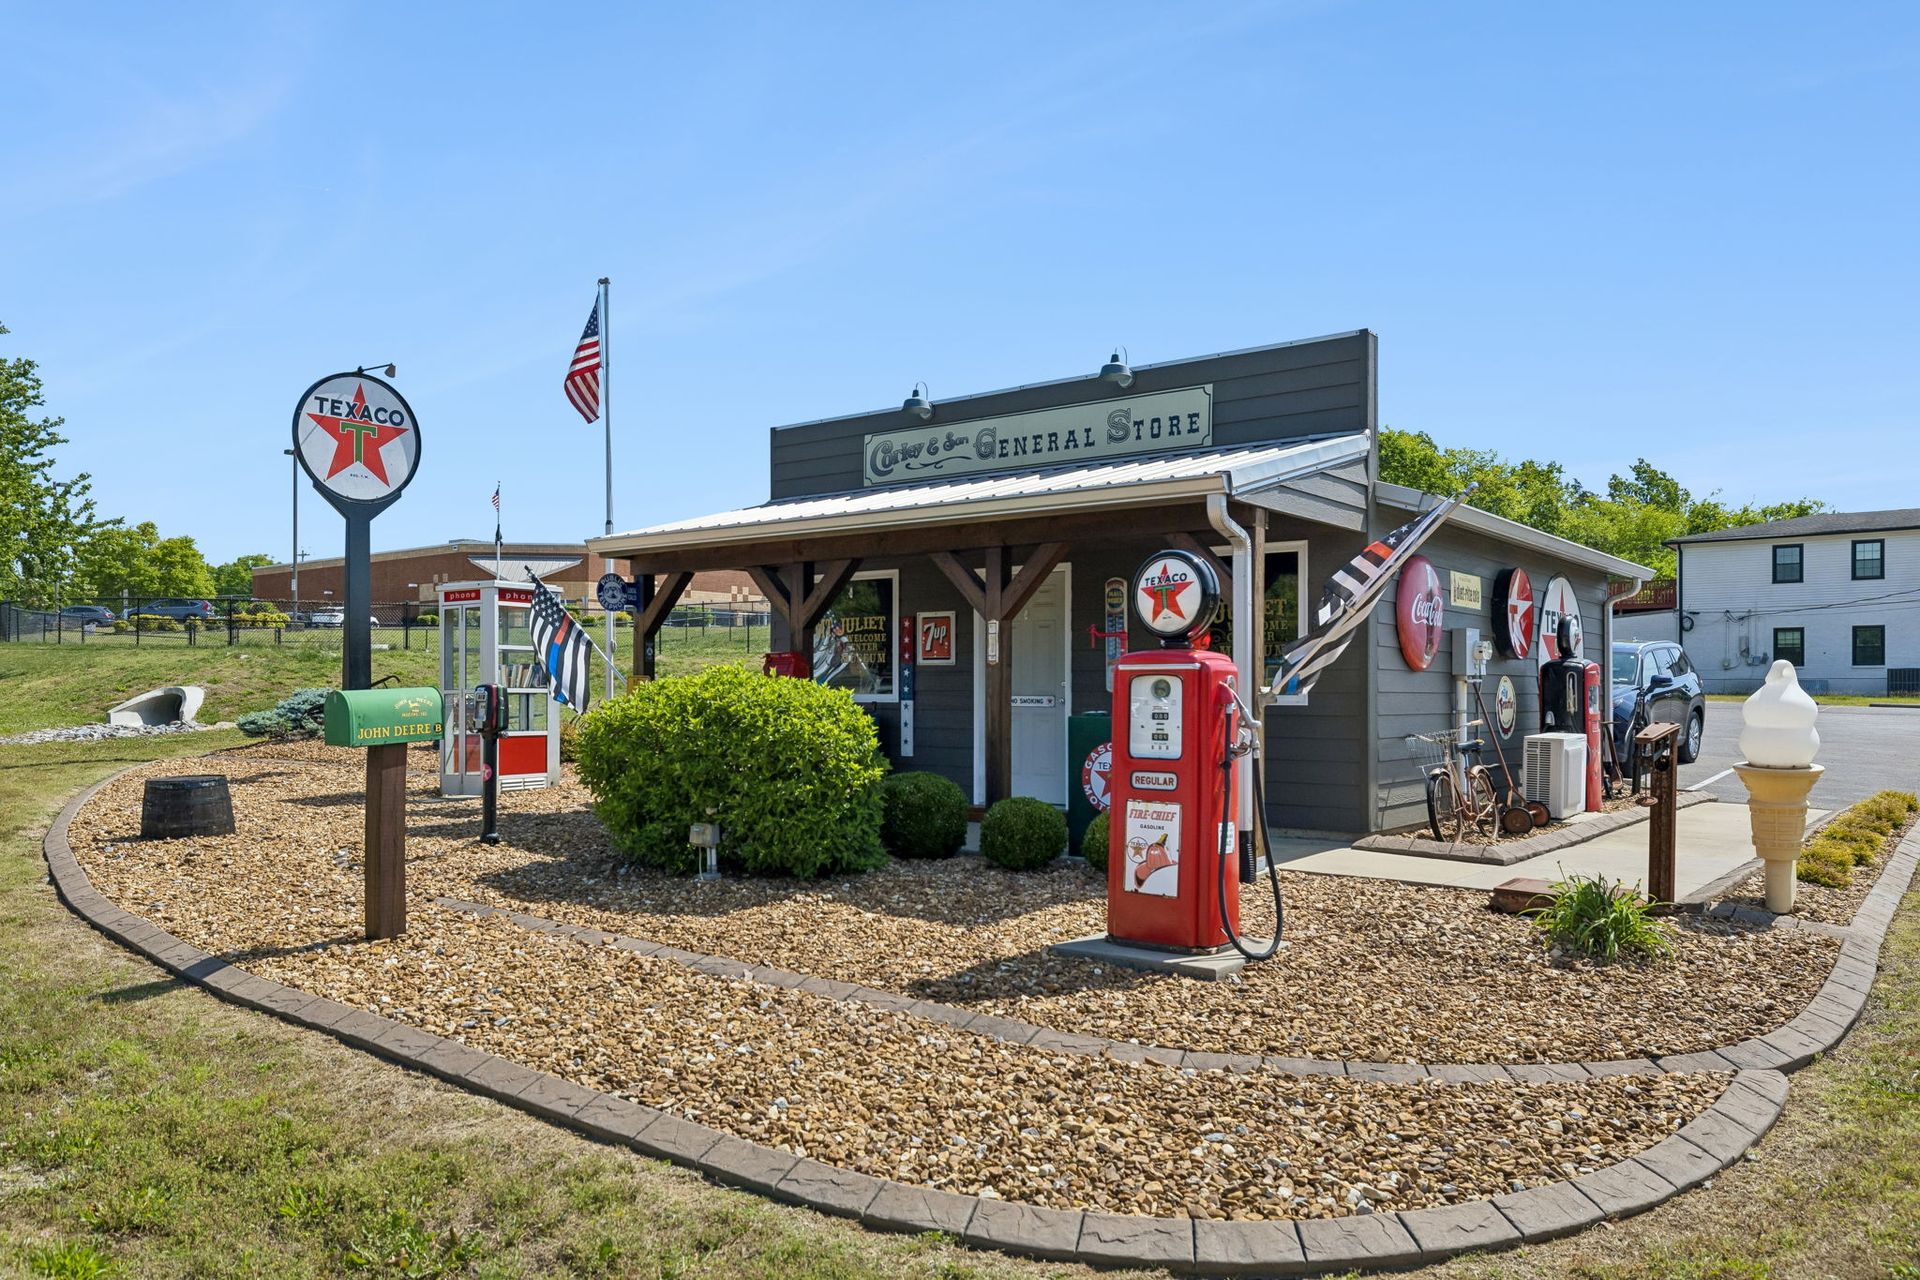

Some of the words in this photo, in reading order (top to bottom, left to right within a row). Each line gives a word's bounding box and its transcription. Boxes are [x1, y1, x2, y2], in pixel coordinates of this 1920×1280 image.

[313, 396, 405, 427] TEXACO
[340, 421, 378, 463] T
[926, 437, 940, 456] &
[973, 426, 1096, 461] GENERAL
[1106, 407, 1200, 445] STORE
[1145, 572, 1188, 587] TEXACO
[450, 592, 477, 601] phone
[505, 592, 533, 601] phon
[840, 616, 886, 636] JULIET
[924, 622, 947, 652] 7up
[357, 726, 390, 739] JOHN
[394, 723, 431, 737] DEERE
[1135, 776, 1175, 787] REGULAR
[1129, 808, 1177, 822] FIRE-CHIEF
